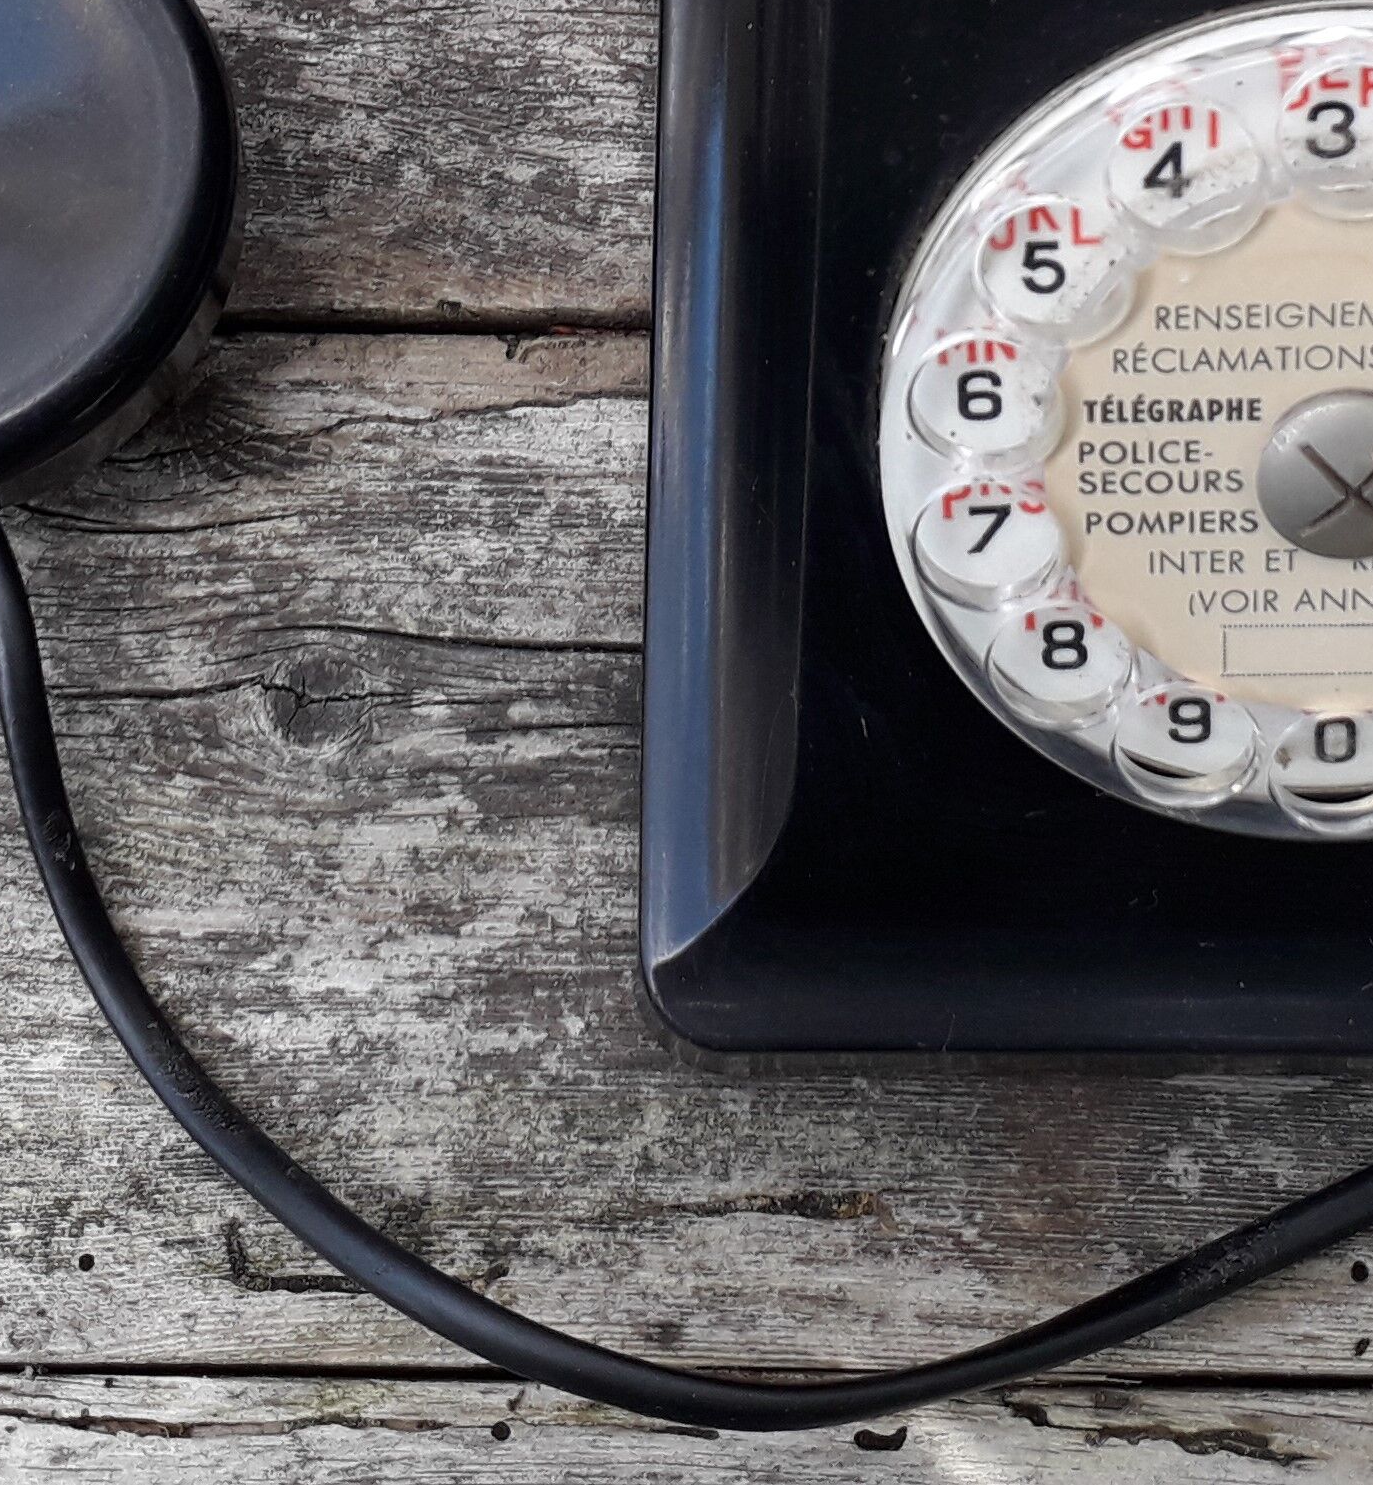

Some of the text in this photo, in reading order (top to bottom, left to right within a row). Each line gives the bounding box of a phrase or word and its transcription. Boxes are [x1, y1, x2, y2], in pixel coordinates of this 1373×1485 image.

[1305, 100, 1356, 159] 3
[1143, 140, 1190, 198] 4
[1023, 241, 1067, 295] 5
[958, 370, 1003, 422] 6
[1084, 394, 1263, 425] TÉLÉGRAPHE
[1079, 440, 1214, 467] POLICE-
[1079, 469, 1245, 497] SECOURS
[966, 503, 1013, 554] 7
[1086, 510, 1260, 537] POMPIERS
[1150, 550, 1246, 576] INTER
[1266, 549, 1300, 574] ET
[1189, 590, 1280, 618] (VOIR
[1041, 620, 1089, 670] 8
[1168, 697, 1212, 744] 9
[1314, 717, 1357, 763] 0
